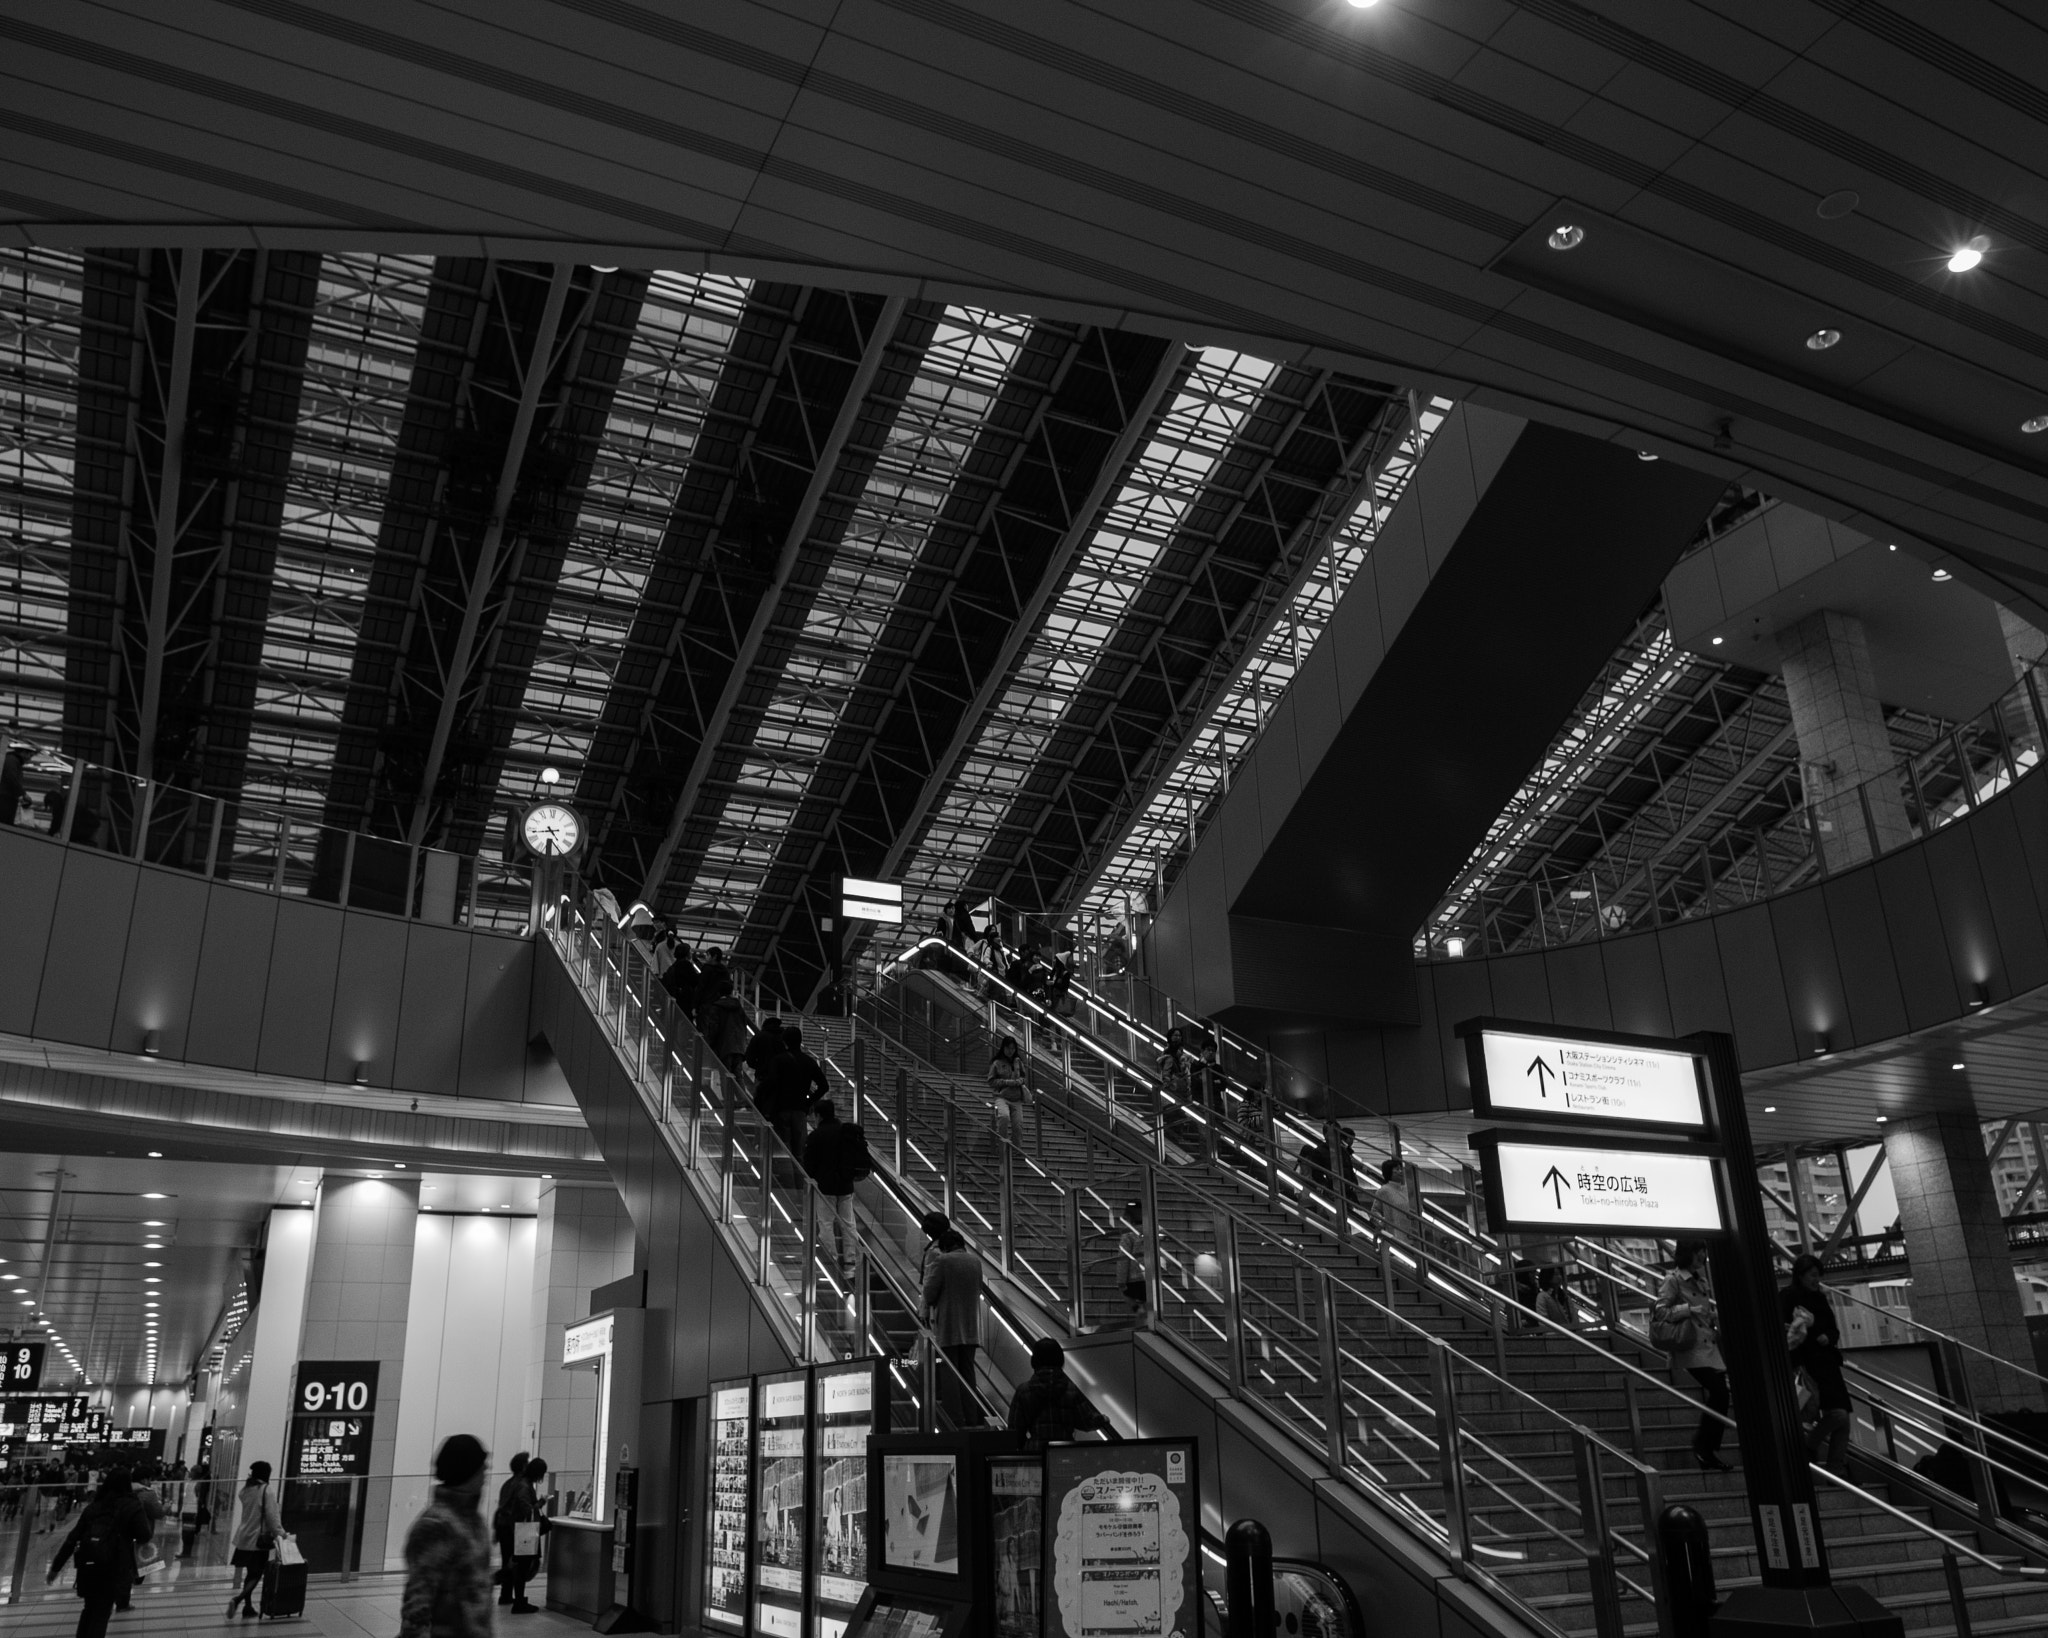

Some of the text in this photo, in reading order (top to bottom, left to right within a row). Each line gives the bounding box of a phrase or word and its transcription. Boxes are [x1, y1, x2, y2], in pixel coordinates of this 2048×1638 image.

[1565, 1051, 1645, 1066] 大阪ステーションシティシネマ
[1568, 1072, 1625, 1086] コナミスポーツクラブ
[1570, 1093, 1610, 1106] レストラン街
[1577, 1172, 1648, 1194] 時空の広場
[1580, 1194, 1659, 1209] Toki-no-hiroba Plaza
[18, 1348, 31, 1363] 9
[13, 1364, 32, 1379] 10
[74, 1399, 81, 1407] 7
[72, 1408, 80, 1417] 8
[42, 1433, 49, 1441] 2
[1096, 1485, 1157, 1494] スノーマンパーク
